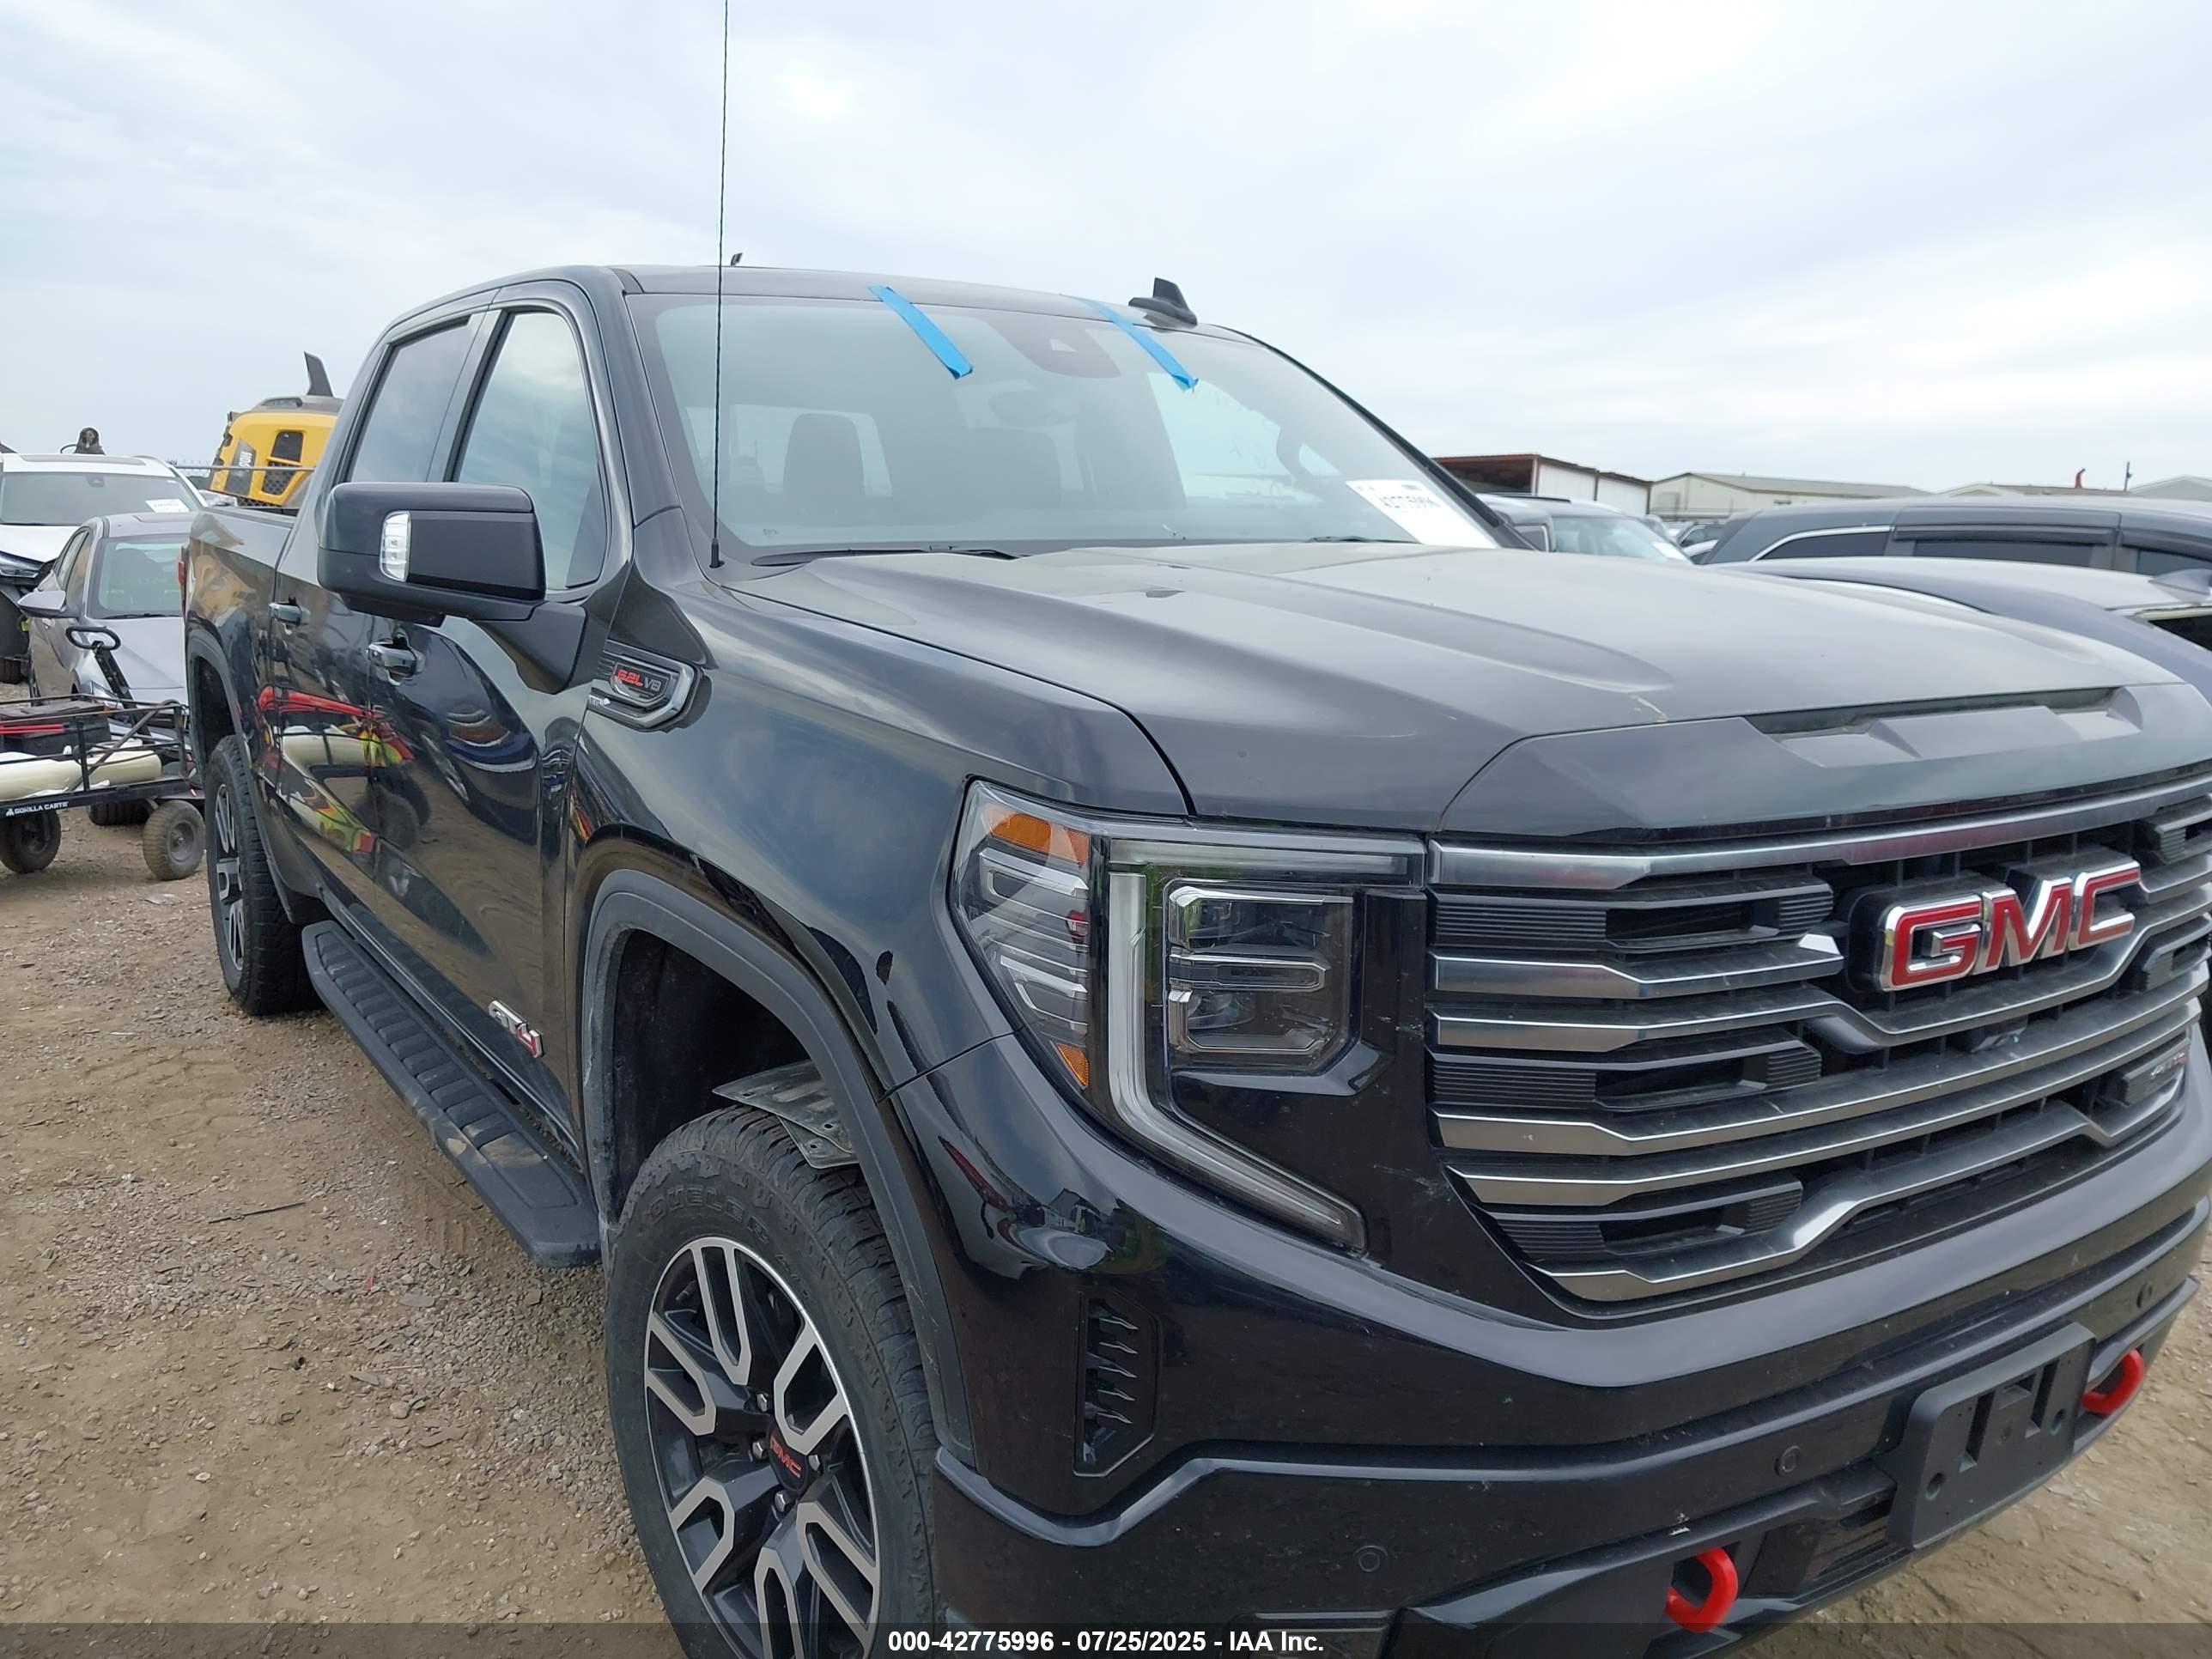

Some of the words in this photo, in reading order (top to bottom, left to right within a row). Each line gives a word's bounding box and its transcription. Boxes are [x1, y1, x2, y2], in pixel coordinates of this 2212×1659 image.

[644, 677, 662, 692] V8
[1879, 859, 2142, 994] GMC
[769, 1435, 803, 1479] GMC
